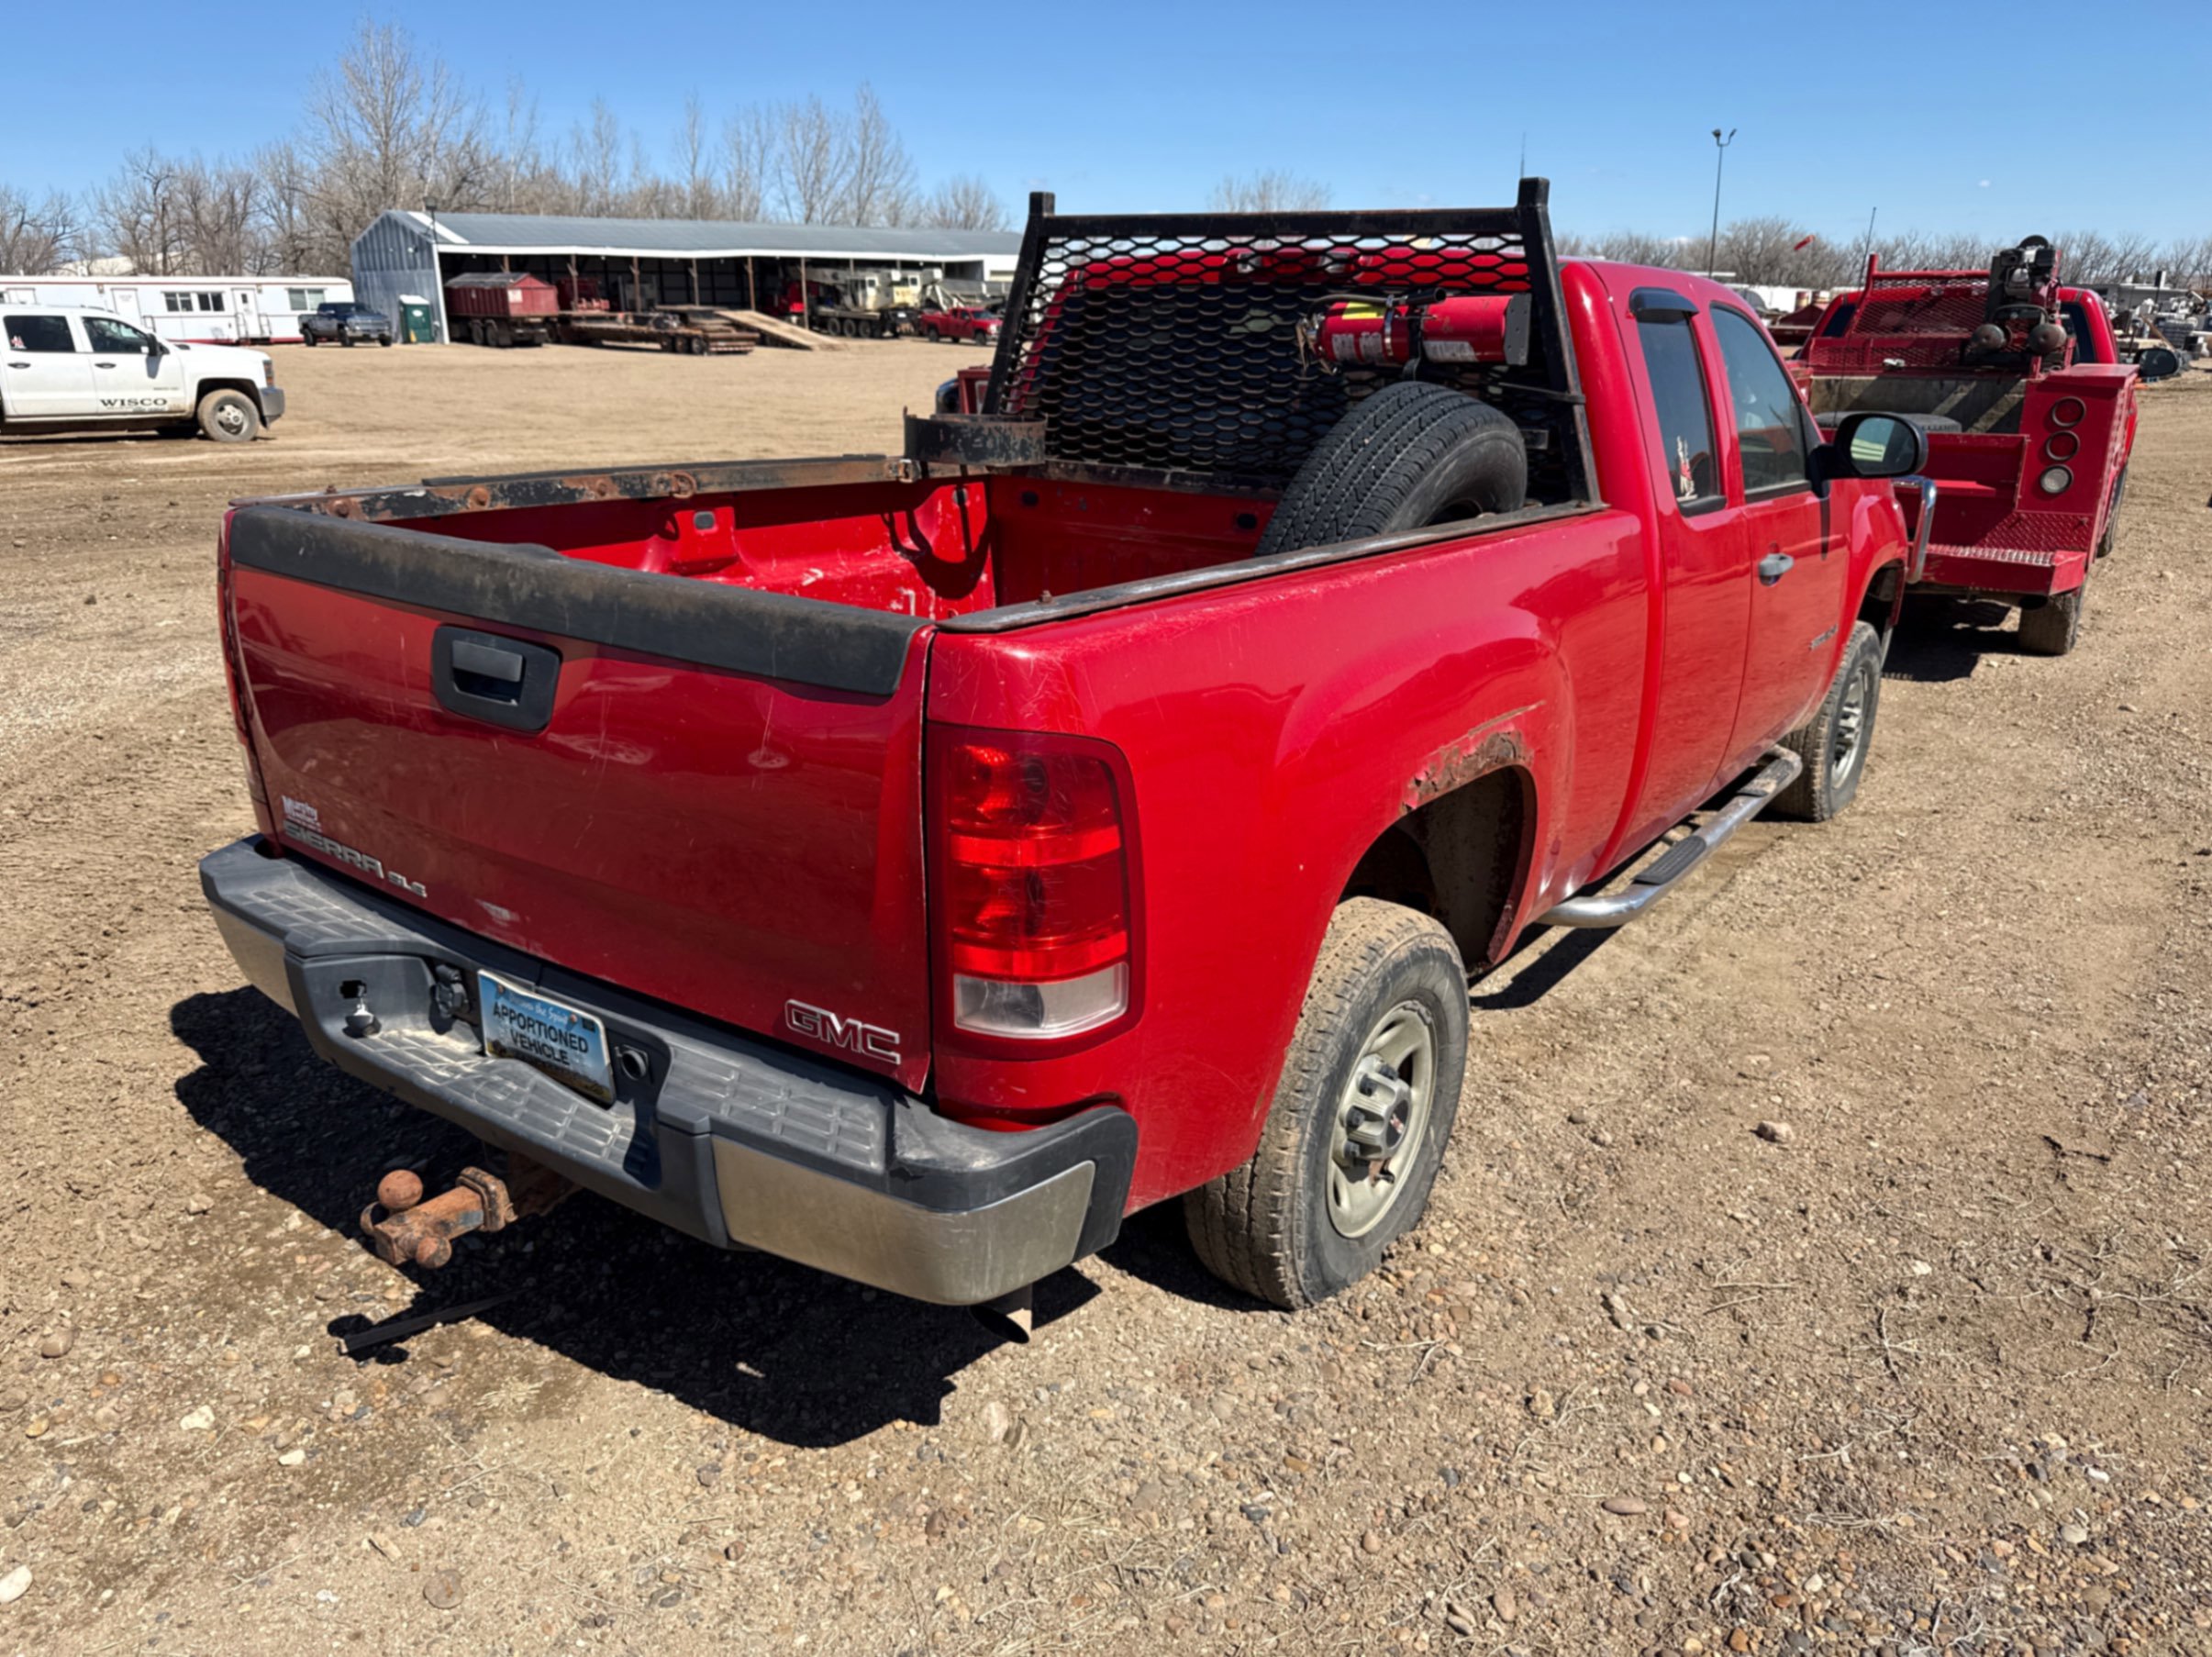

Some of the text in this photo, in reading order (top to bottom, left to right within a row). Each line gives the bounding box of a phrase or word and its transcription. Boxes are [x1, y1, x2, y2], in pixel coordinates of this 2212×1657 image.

[99, 398, 168, 406] WISCO
[283, 819, 384, 878] SIERRA
[493, 1002, 589, 1054] APPORTIONED
[510, 1029, 571, 1066] VEHICLE
[784, 997, 902, 1065] GMC
